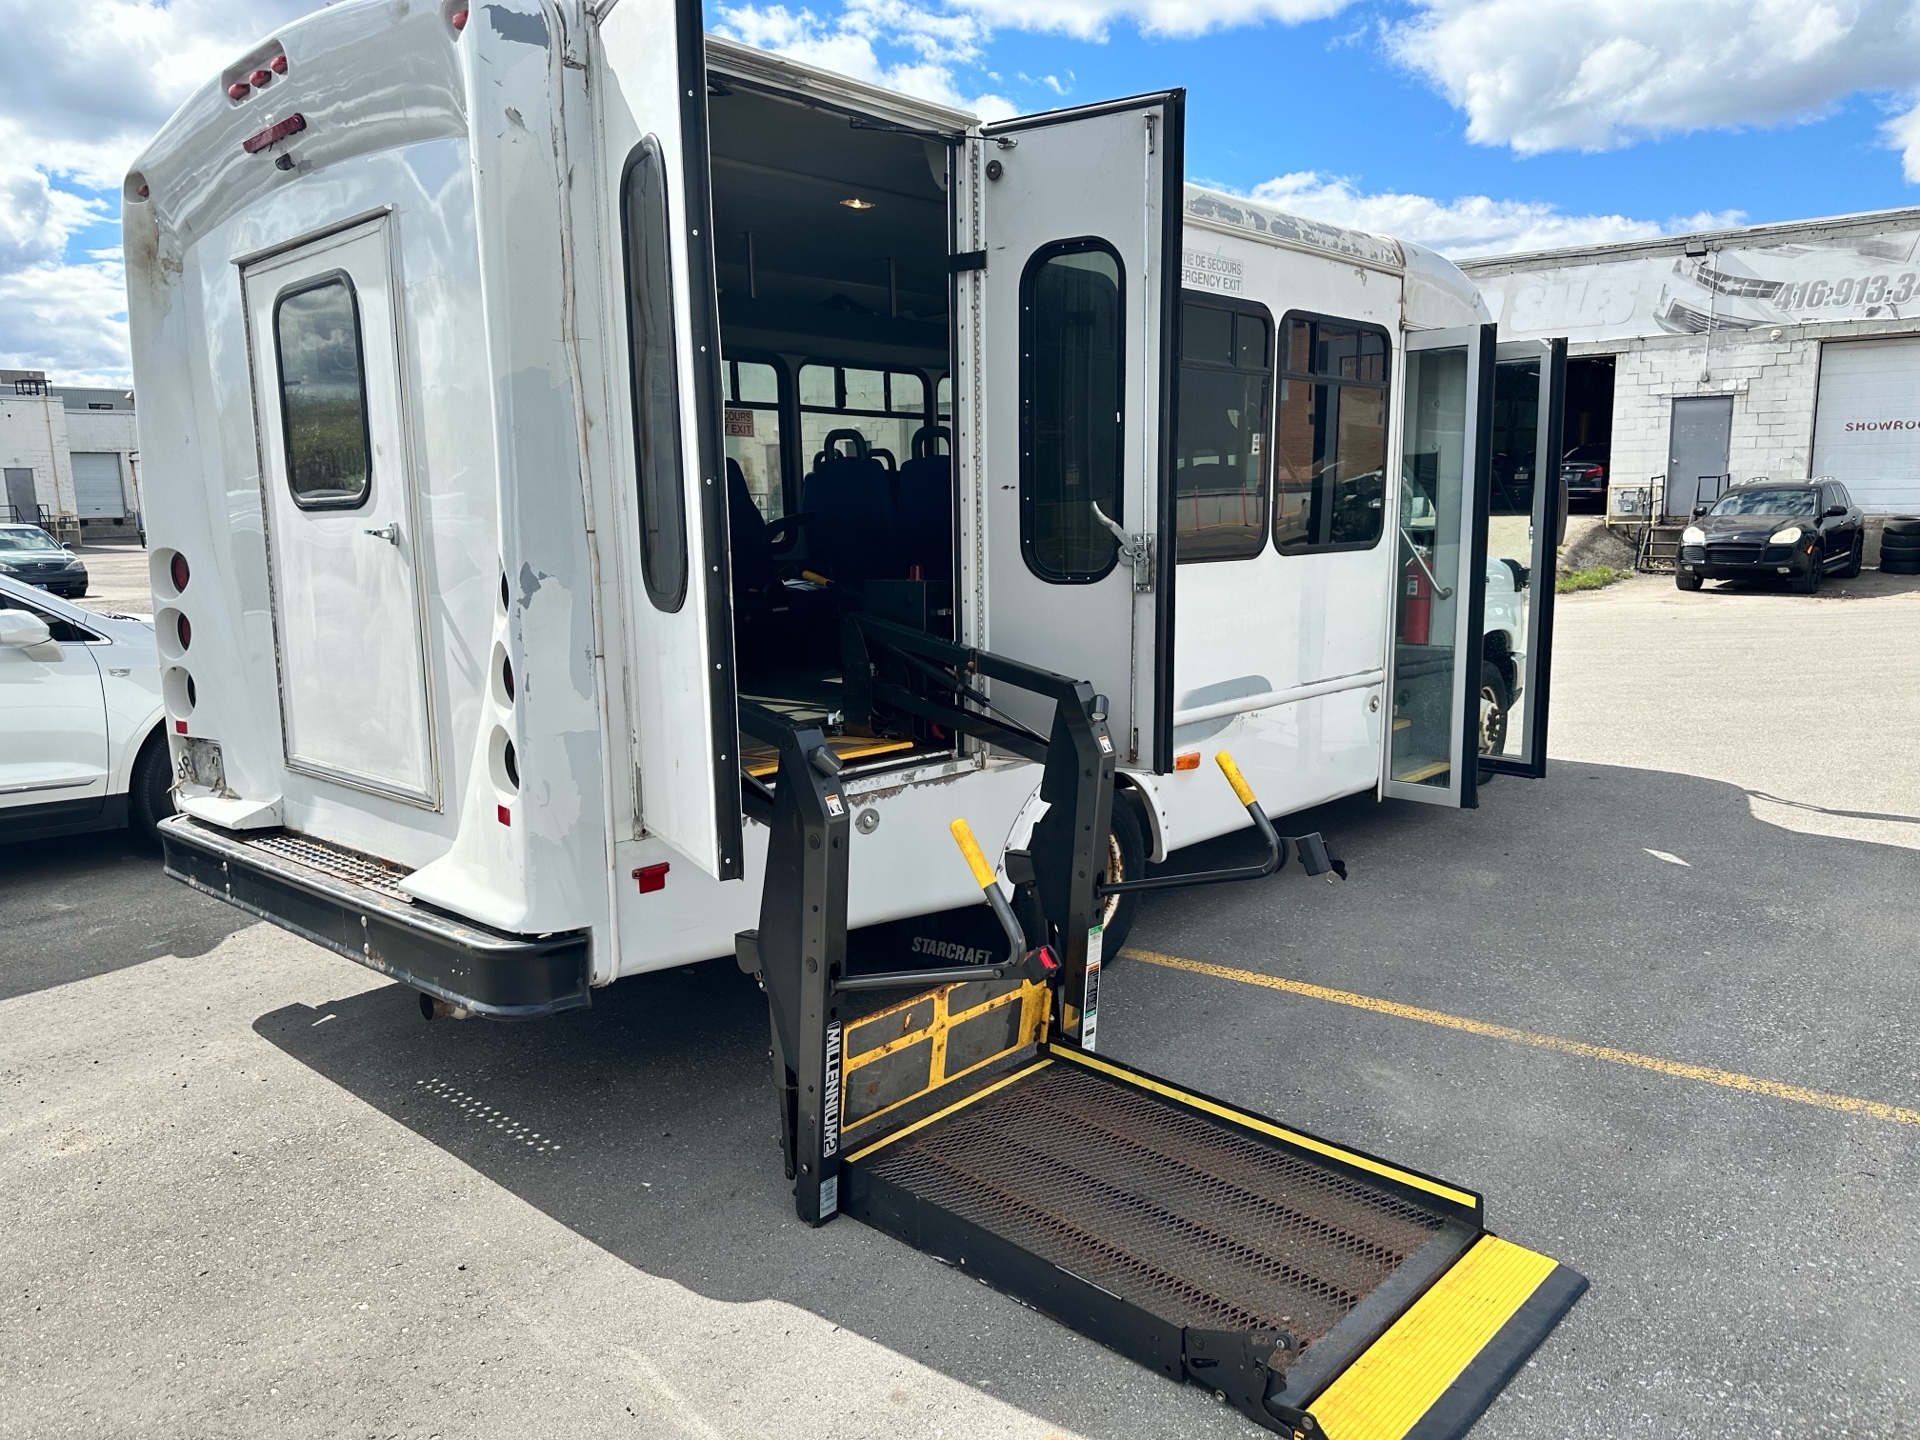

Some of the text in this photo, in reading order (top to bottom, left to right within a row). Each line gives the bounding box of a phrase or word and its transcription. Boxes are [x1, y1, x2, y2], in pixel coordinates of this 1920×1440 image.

[1195, 254, 1206, 268] DE
[1207, 257, 1242, 275] SECOURS
[1223, 277, 1241, 291] EXIT
[731, 424, 752, 434] EXIT
[911, 936, 993, 965] STARCRAFT
